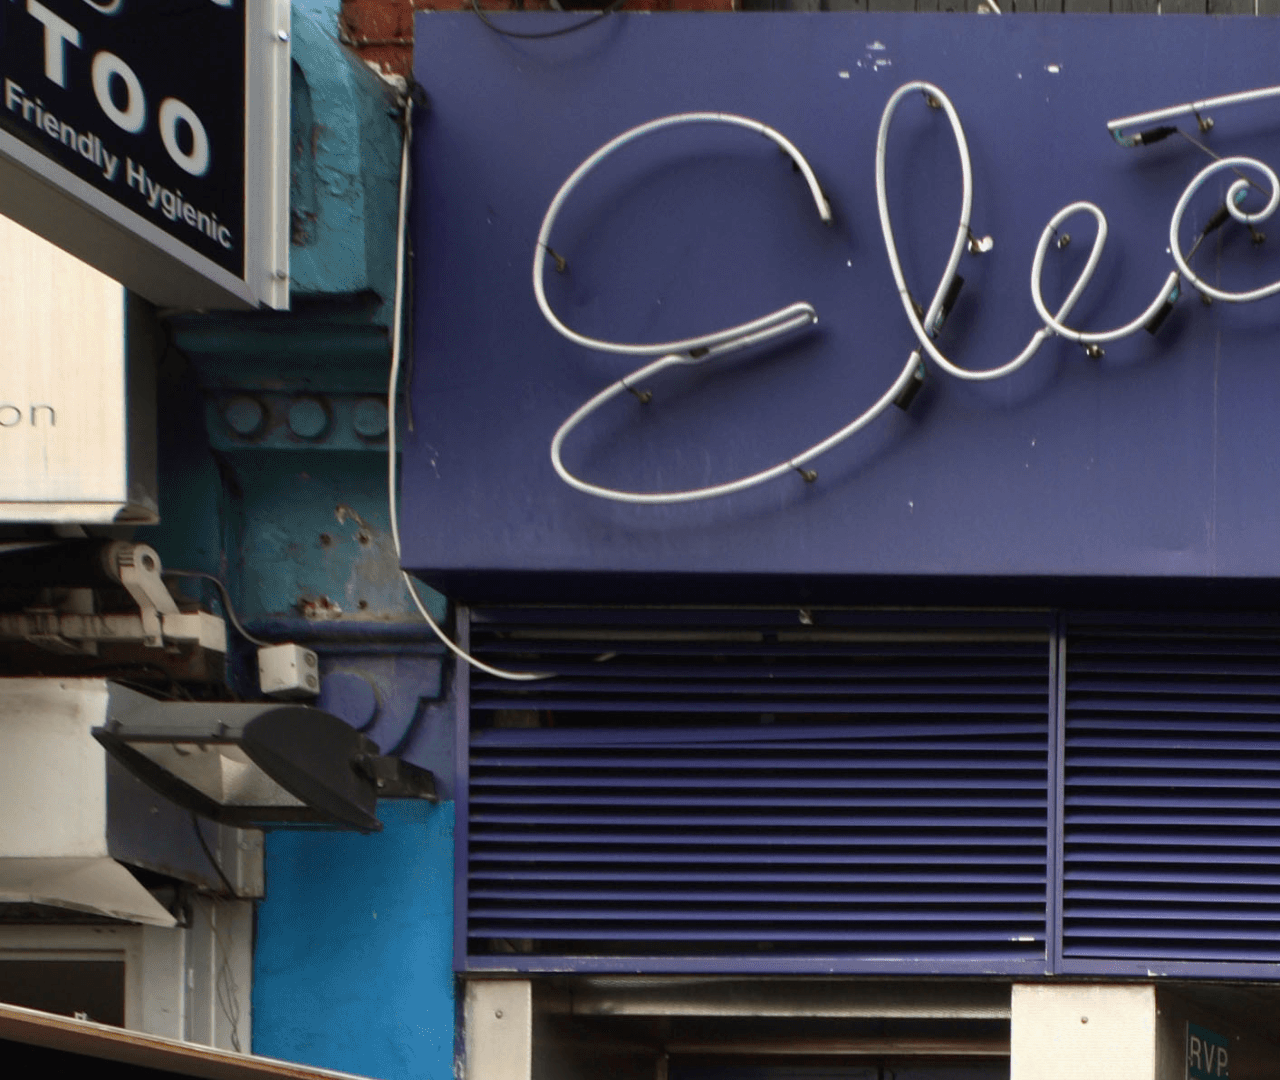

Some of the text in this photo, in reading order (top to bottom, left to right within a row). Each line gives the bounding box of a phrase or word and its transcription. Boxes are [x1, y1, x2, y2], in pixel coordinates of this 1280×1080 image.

[4, 79, 232, 250] Friendly Hygienic
[25, 0, 211, 177] TOO
